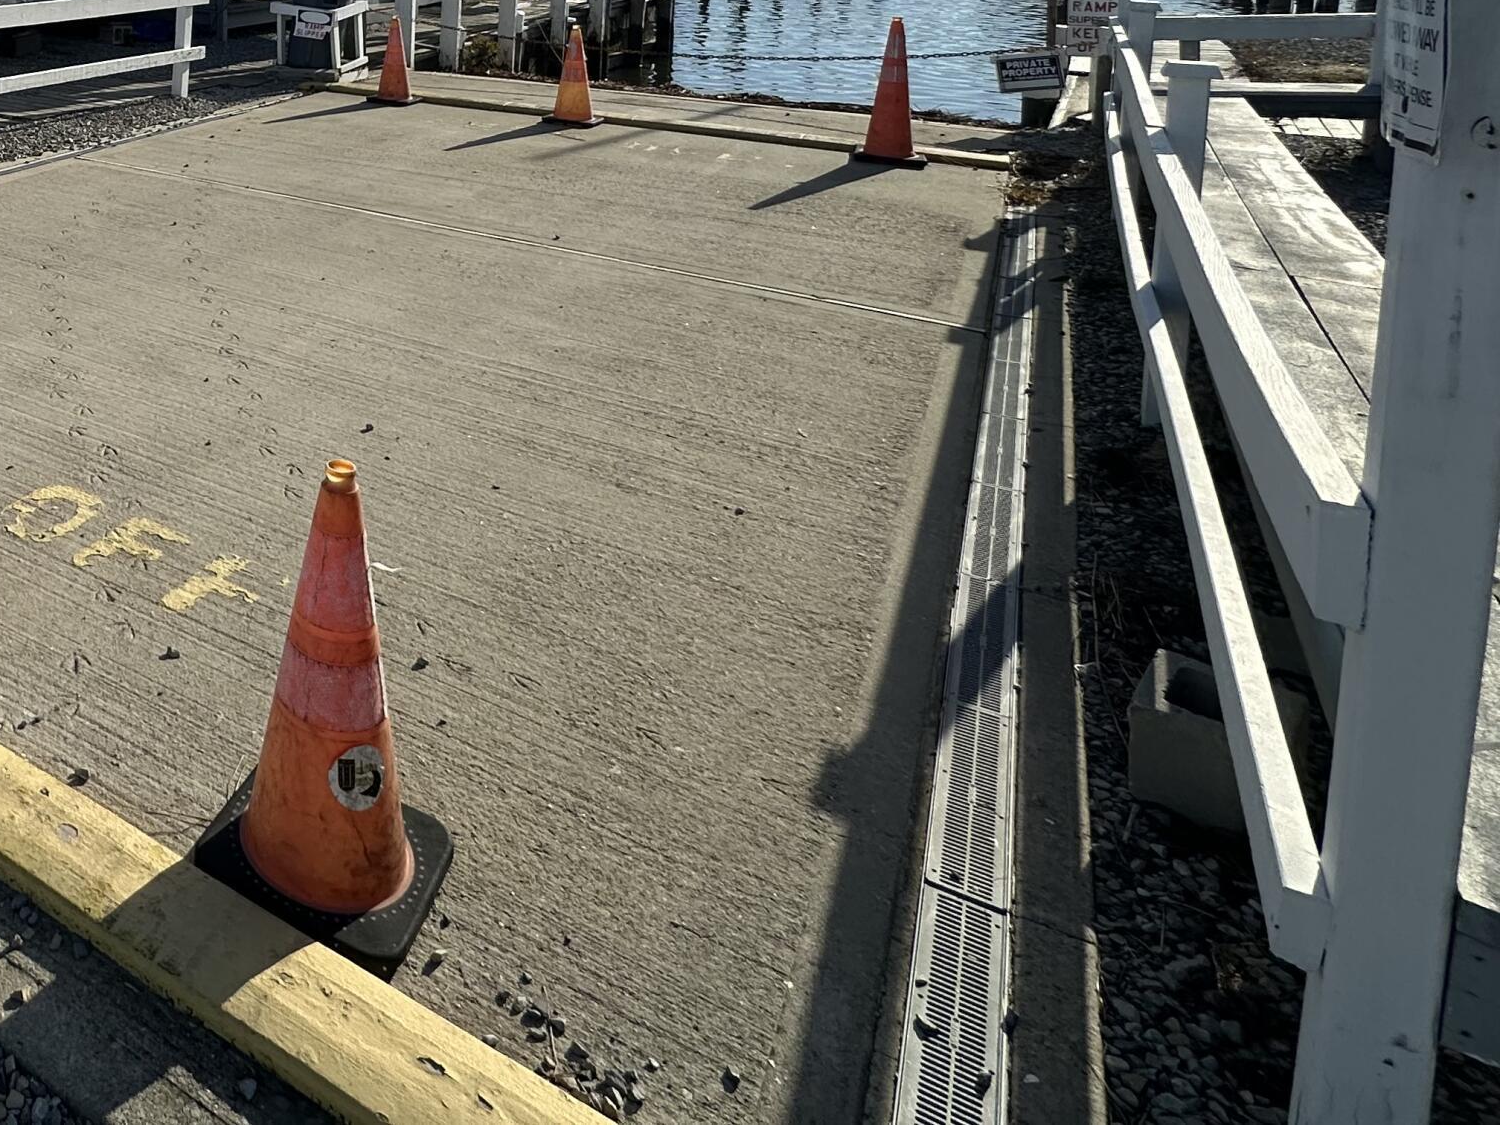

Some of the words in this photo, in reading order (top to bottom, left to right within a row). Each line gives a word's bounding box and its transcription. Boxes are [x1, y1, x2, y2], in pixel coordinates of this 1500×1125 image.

[1072, 1, 1118, 13] RAMP
[1006, 59, 1051, 69] PRIVATE
[1002, 66, 1057, 77] PROPERTY
